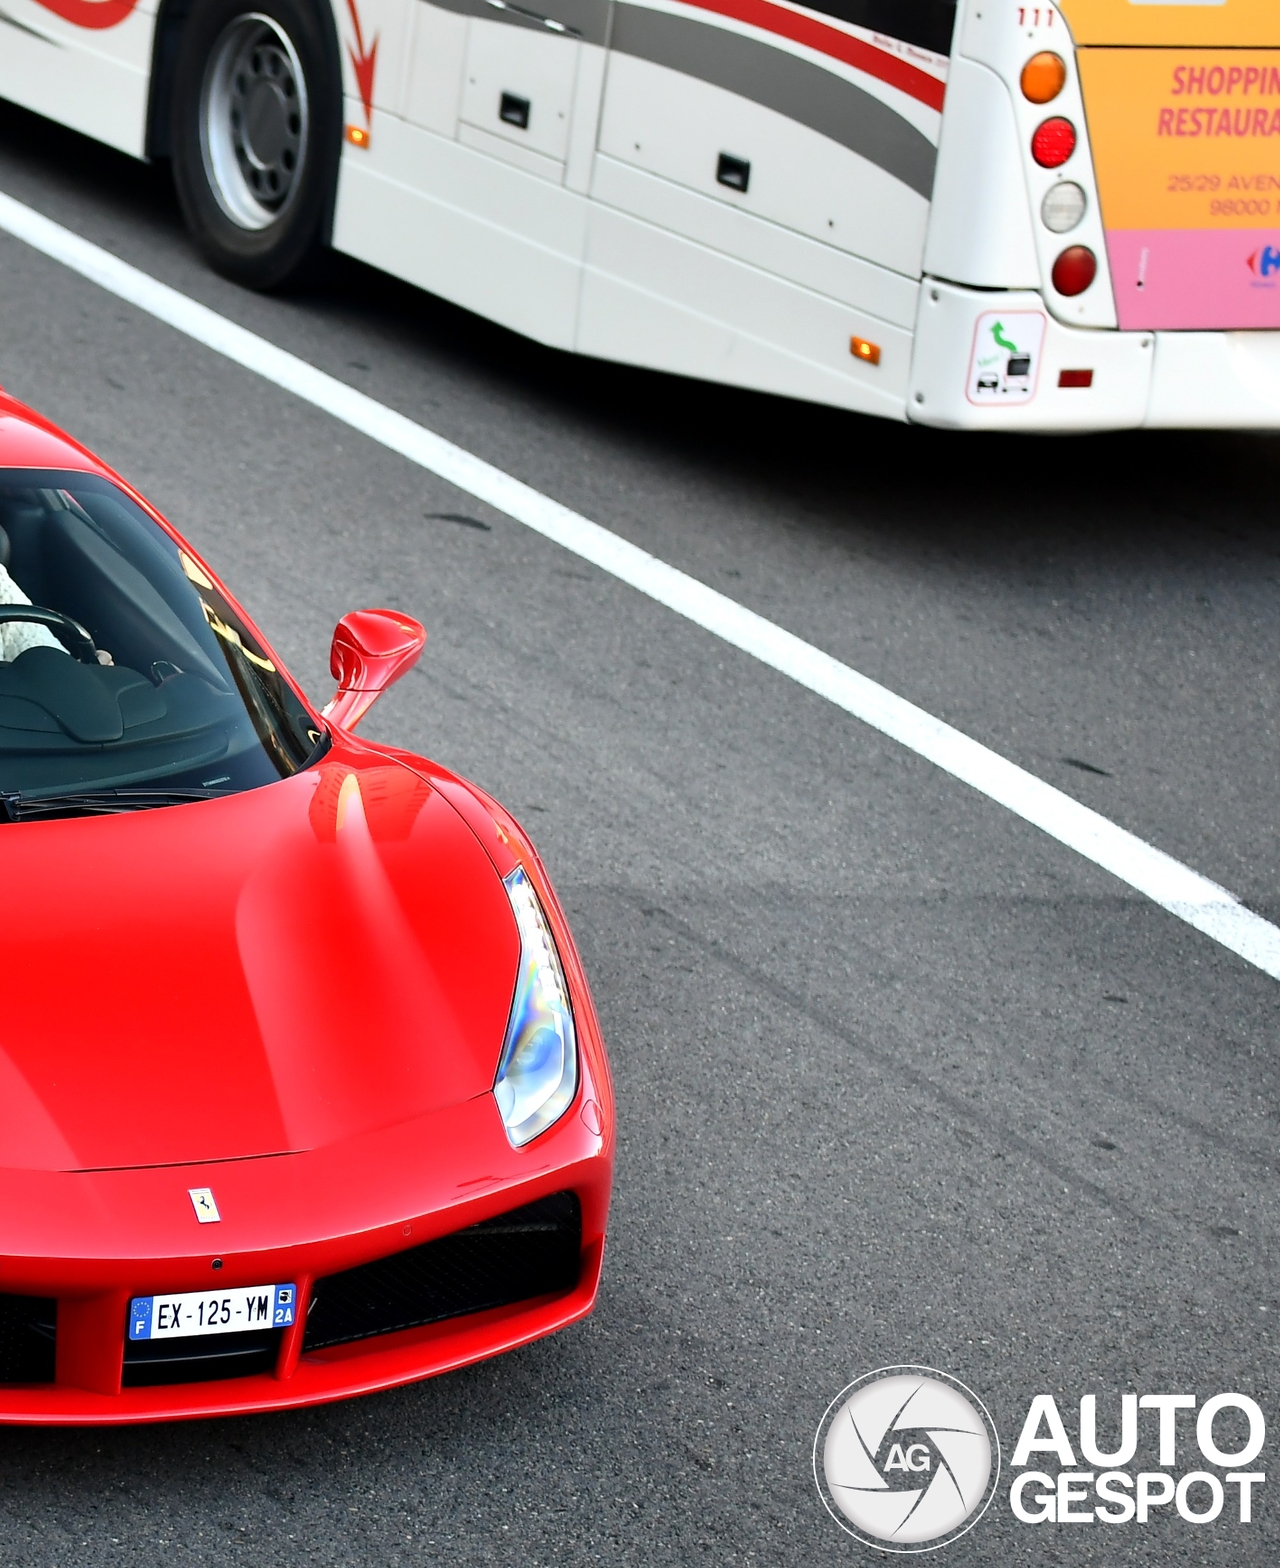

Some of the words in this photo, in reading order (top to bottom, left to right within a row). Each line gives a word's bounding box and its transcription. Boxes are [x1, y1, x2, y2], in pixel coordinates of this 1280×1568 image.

[1018, 7, 1053, 26] 111
[1157, 107, 1280, 136] RESTAURA
[1167, 174, 1221, 192] 25/29
[1210, 199, 1269, 216] 98000
[157, 1295, 269, 1330] EX-125-YM
[275, 1308, 293, 1323] 2A
[135, 1321, 146, 1335] F
